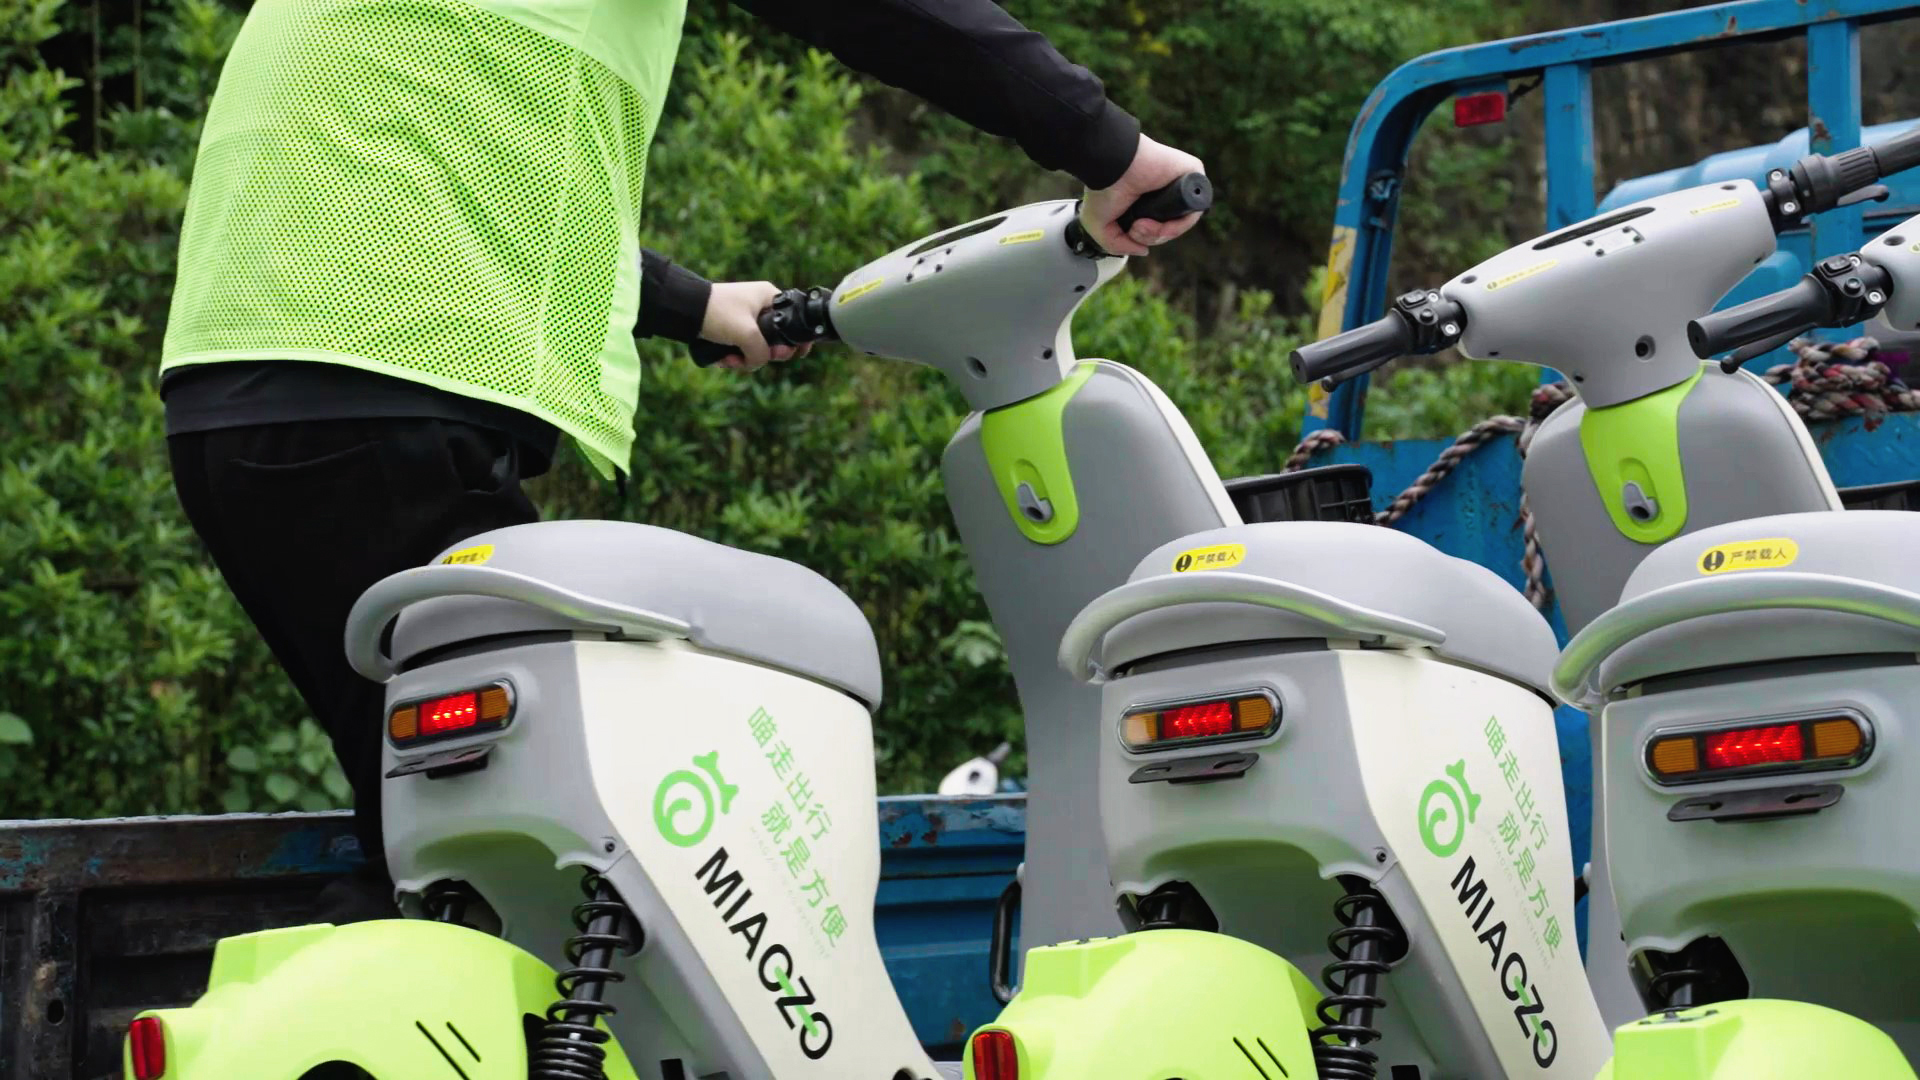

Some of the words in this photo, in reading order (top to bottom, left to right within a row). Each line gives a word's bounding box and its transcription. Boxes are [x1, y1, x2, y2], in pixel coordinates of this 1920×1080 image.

[747, 705, 833, 841] 喵走出行
[1483, 714, 1549, 851] 喵走出行
[761, 801, 848, 948] 就是方便
[1497, 810, 1563, 959] 就是方便
[694, 846, 833, 1060] MIAOZO
[1450, 855, 1558, 1069] MIAOZO
